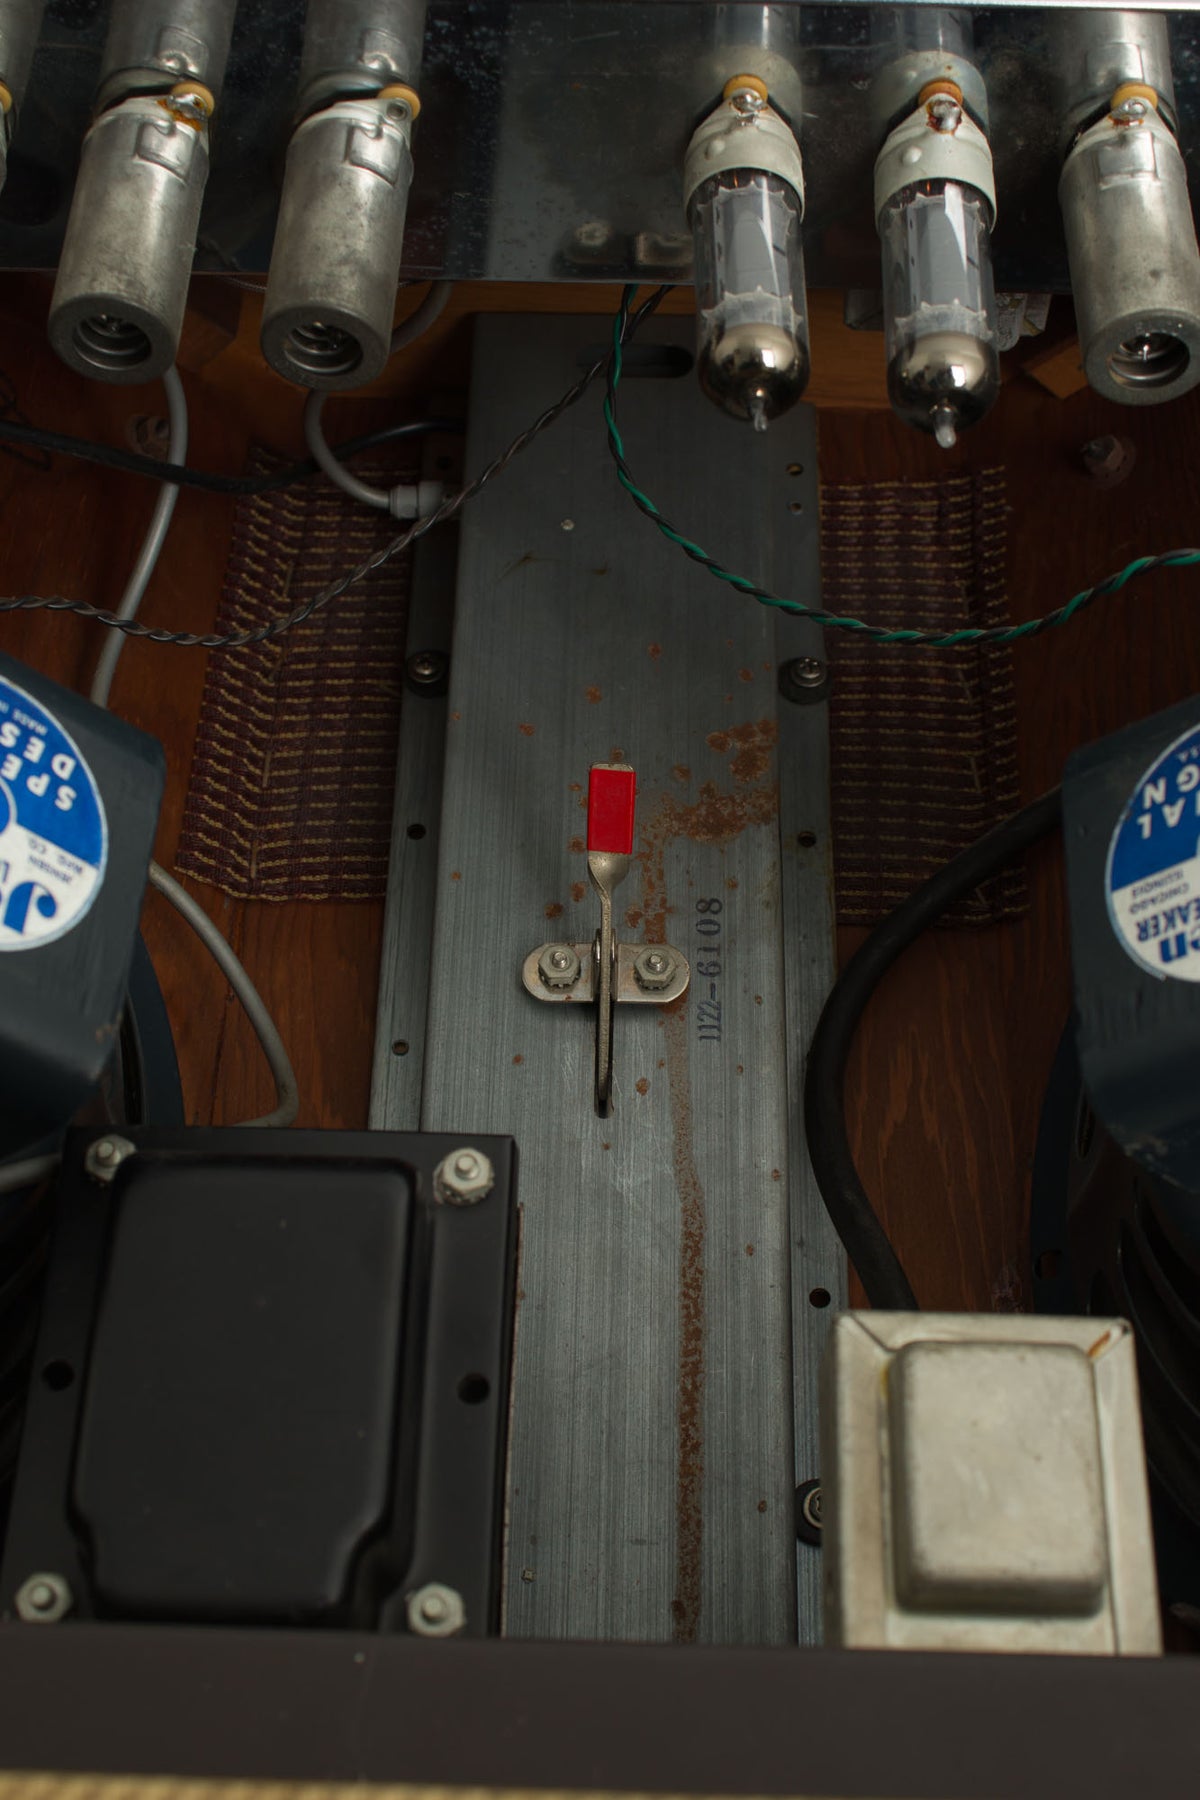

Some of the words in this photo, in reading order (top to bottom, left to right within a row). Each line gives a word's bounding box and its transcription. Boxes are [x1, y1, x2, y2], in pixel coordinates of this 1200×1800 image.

[0, 721, 77, 781] DES
[0, 753, 77, 811] SPE
[1143, 763, 1200, 810] GN
[696, 898, 723, 1042] 1122-6108
